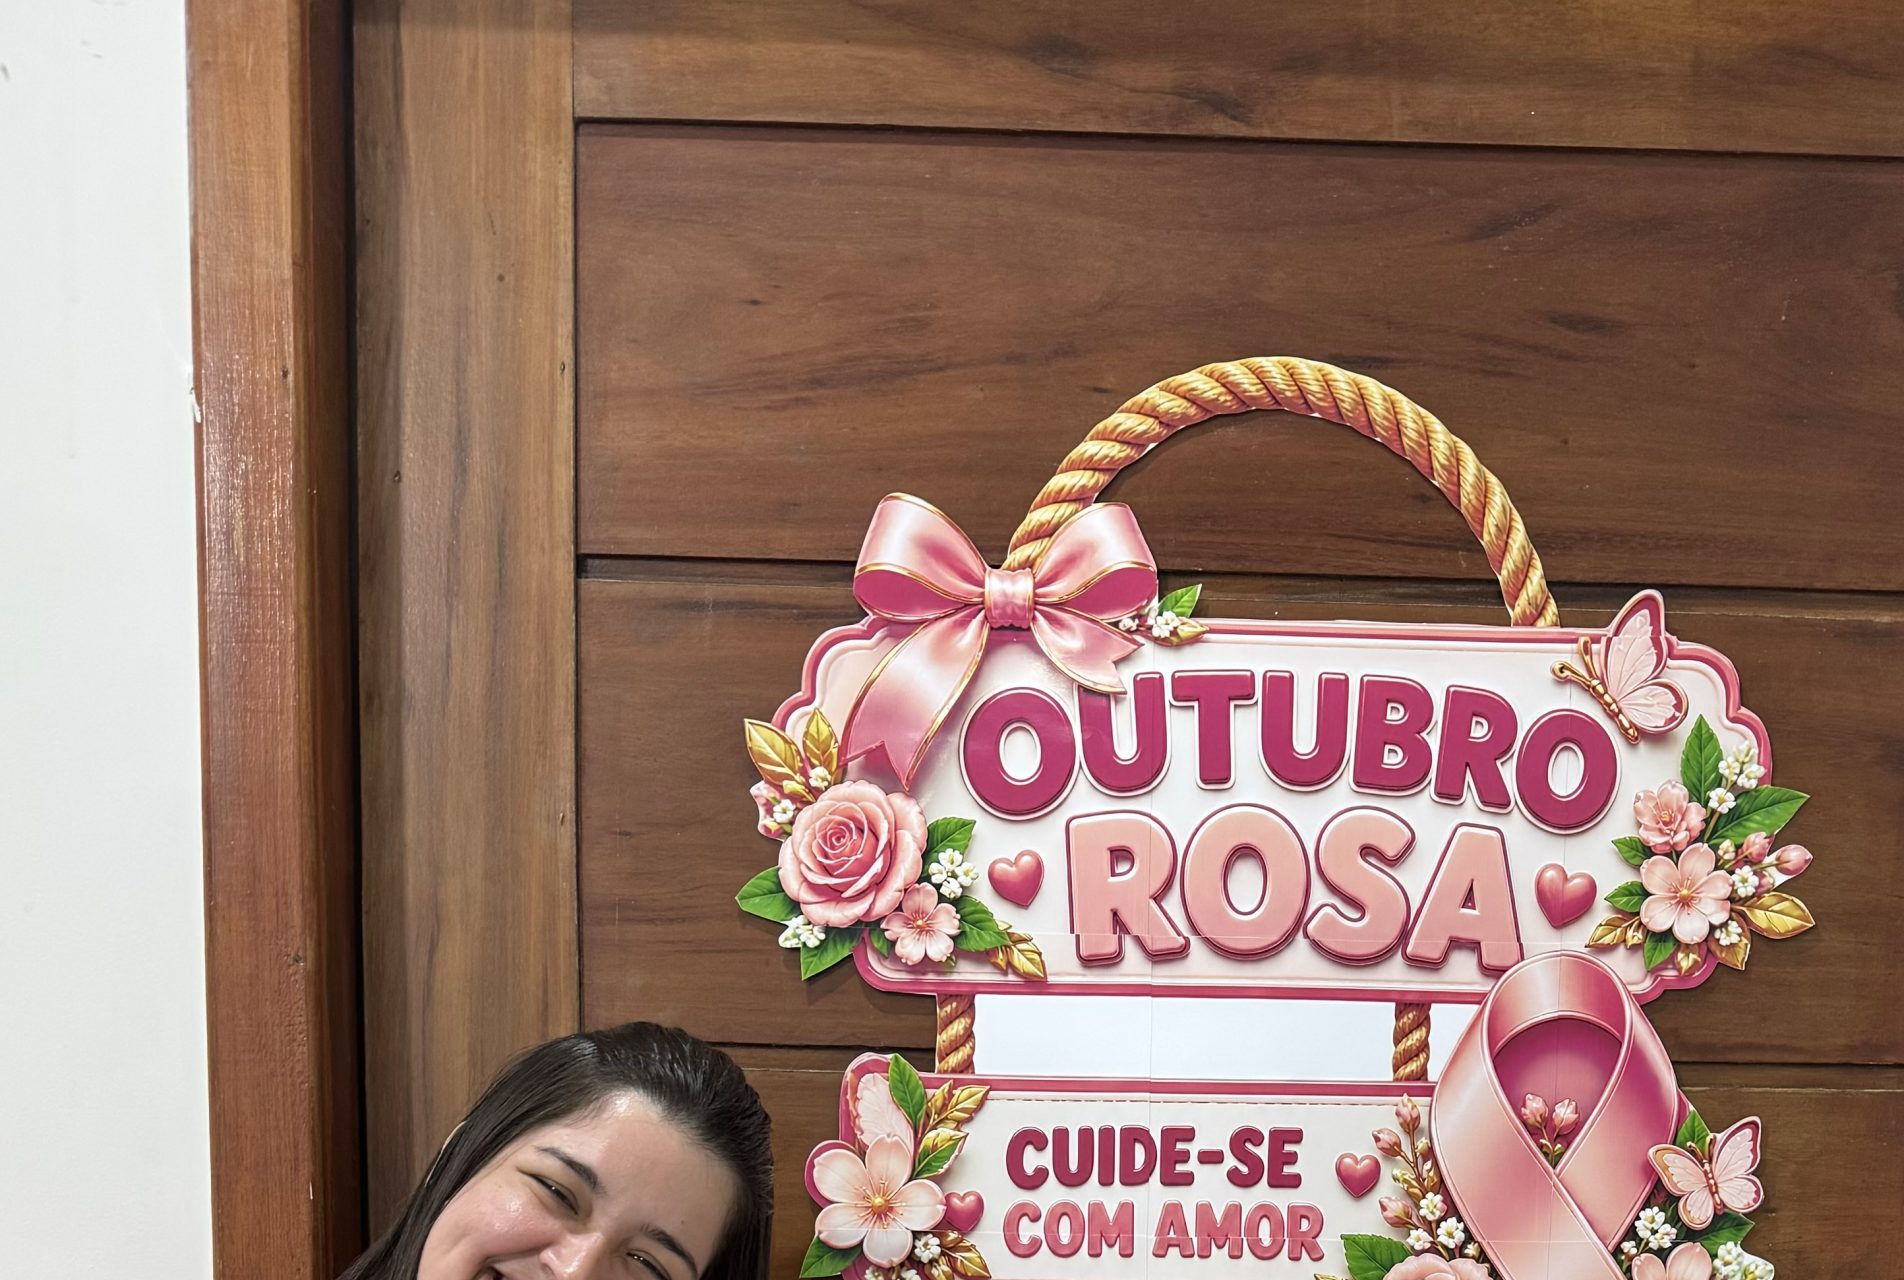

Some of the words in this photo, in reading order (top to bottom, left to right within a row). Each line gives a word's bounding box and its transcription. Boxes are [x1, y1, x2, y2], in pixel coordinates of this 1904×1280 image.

[961, 669, 1619, 830] OUTUBRO
[1066, 803, 1525, 975] ROSA
[1006, 1125, 1304, 1190] CUIDE-SE
[1003, 1200, 1135, 1258] COM
[1152, 1200, 1325, 1261] AMOR
